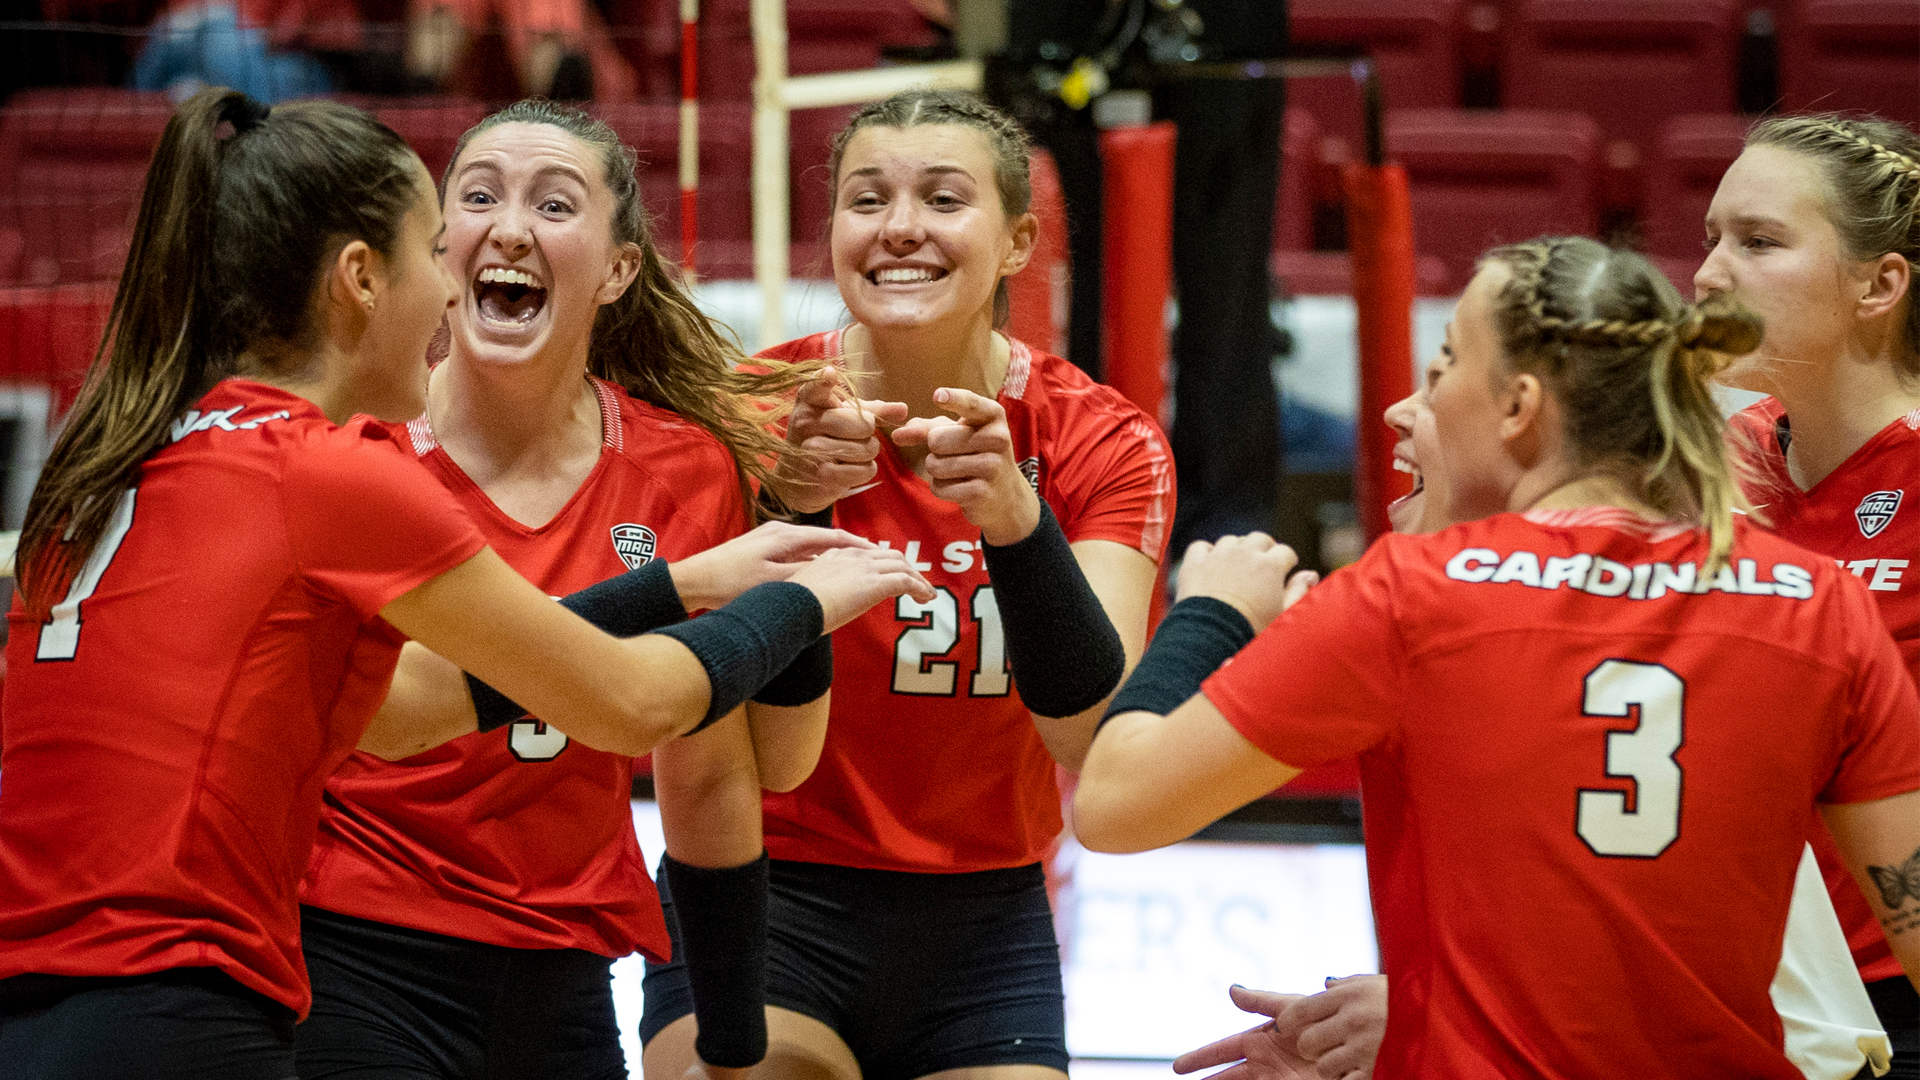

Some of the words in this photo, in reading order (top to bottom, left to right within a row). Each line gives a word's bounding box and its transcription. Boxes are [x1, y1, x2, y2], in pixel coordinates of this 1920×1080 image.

[1855, 500, 1898, 514] MAC
[617, 540, 653, 555] MAC
[1445, 548, 1814, 599] CARDINALS
[1834, 558, 1910, 592] TE
[890, 585, 1010, 697] 21
[1575, 657, 1685, 859] 3
